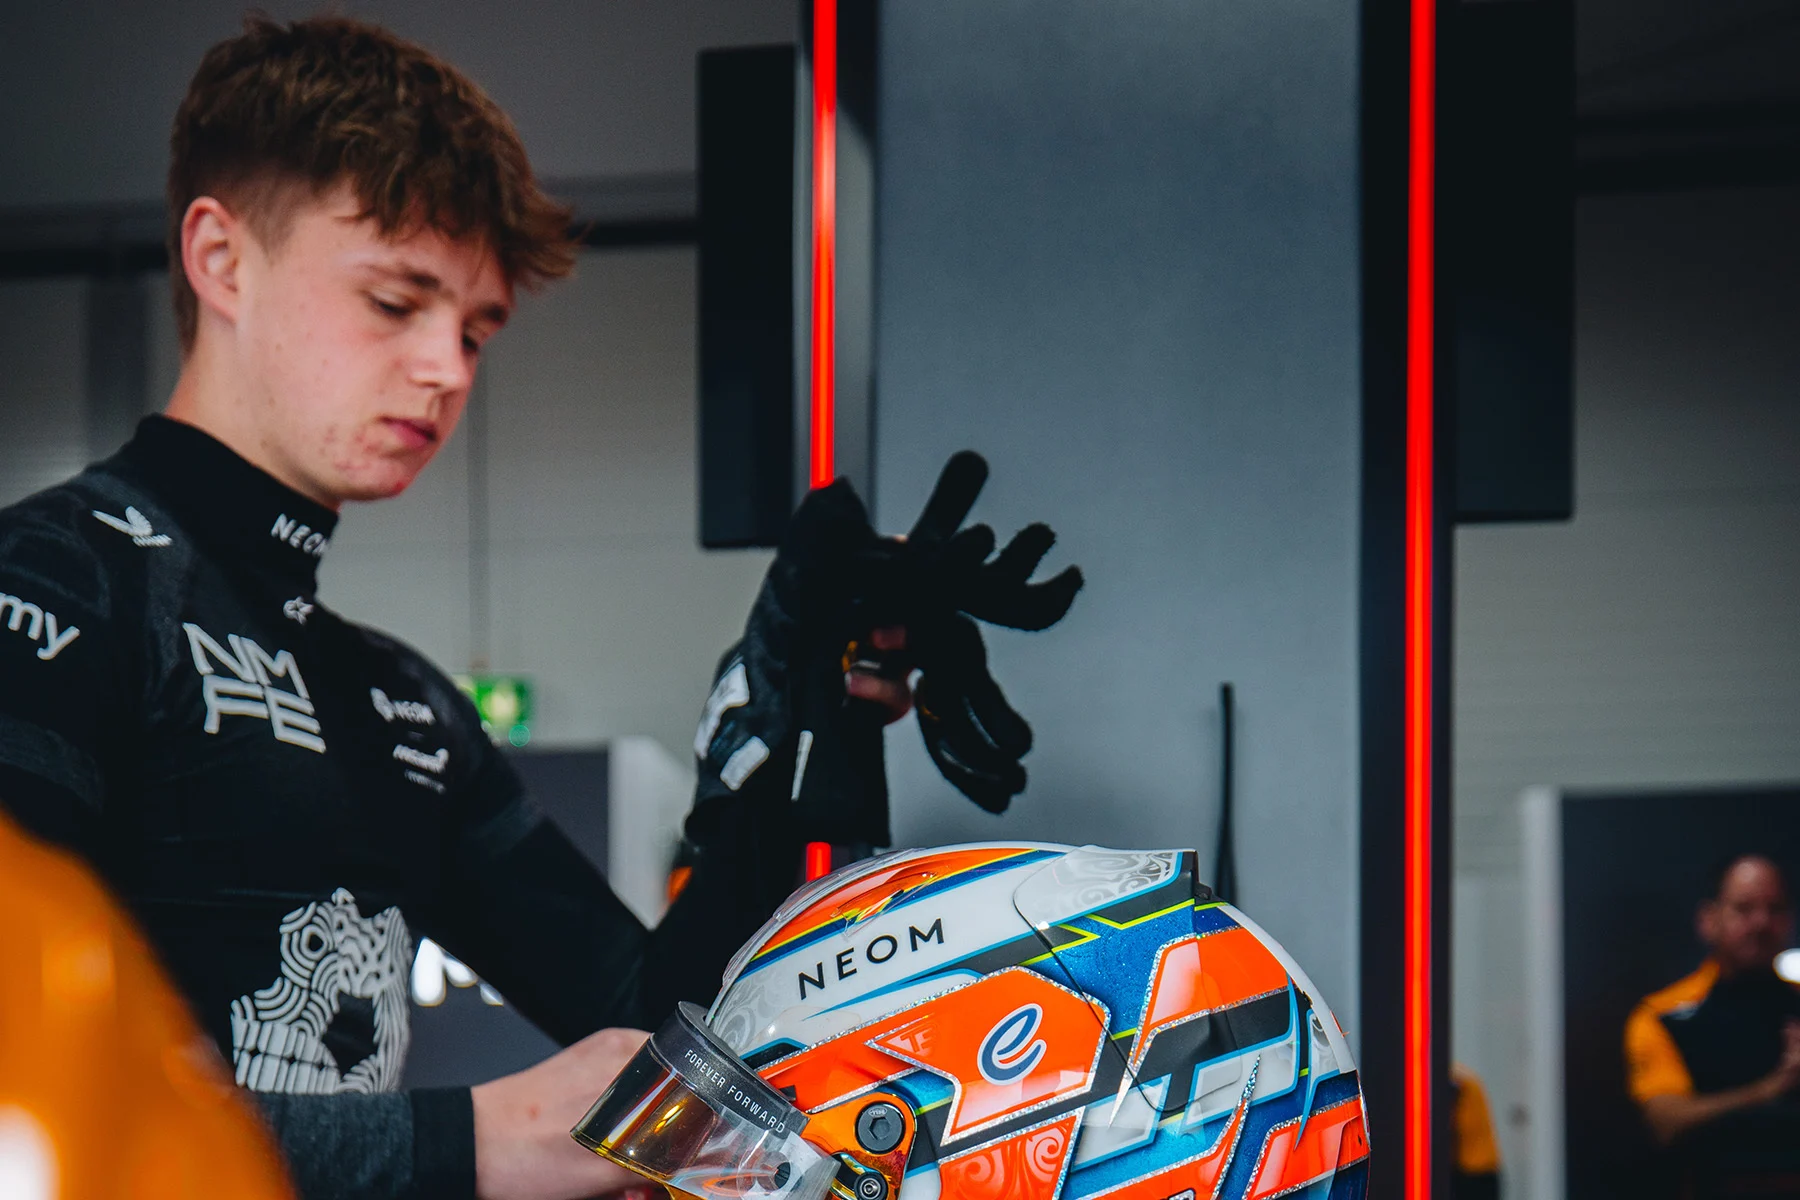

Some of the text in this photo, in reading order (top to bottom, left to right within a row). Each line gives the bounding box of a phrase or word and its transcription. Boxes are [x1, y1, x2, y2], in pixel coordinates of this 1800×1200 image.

[798, 917, 945, 1001] NEOM
[684, 1049, 786, 1134] FOREVER FORWARD
